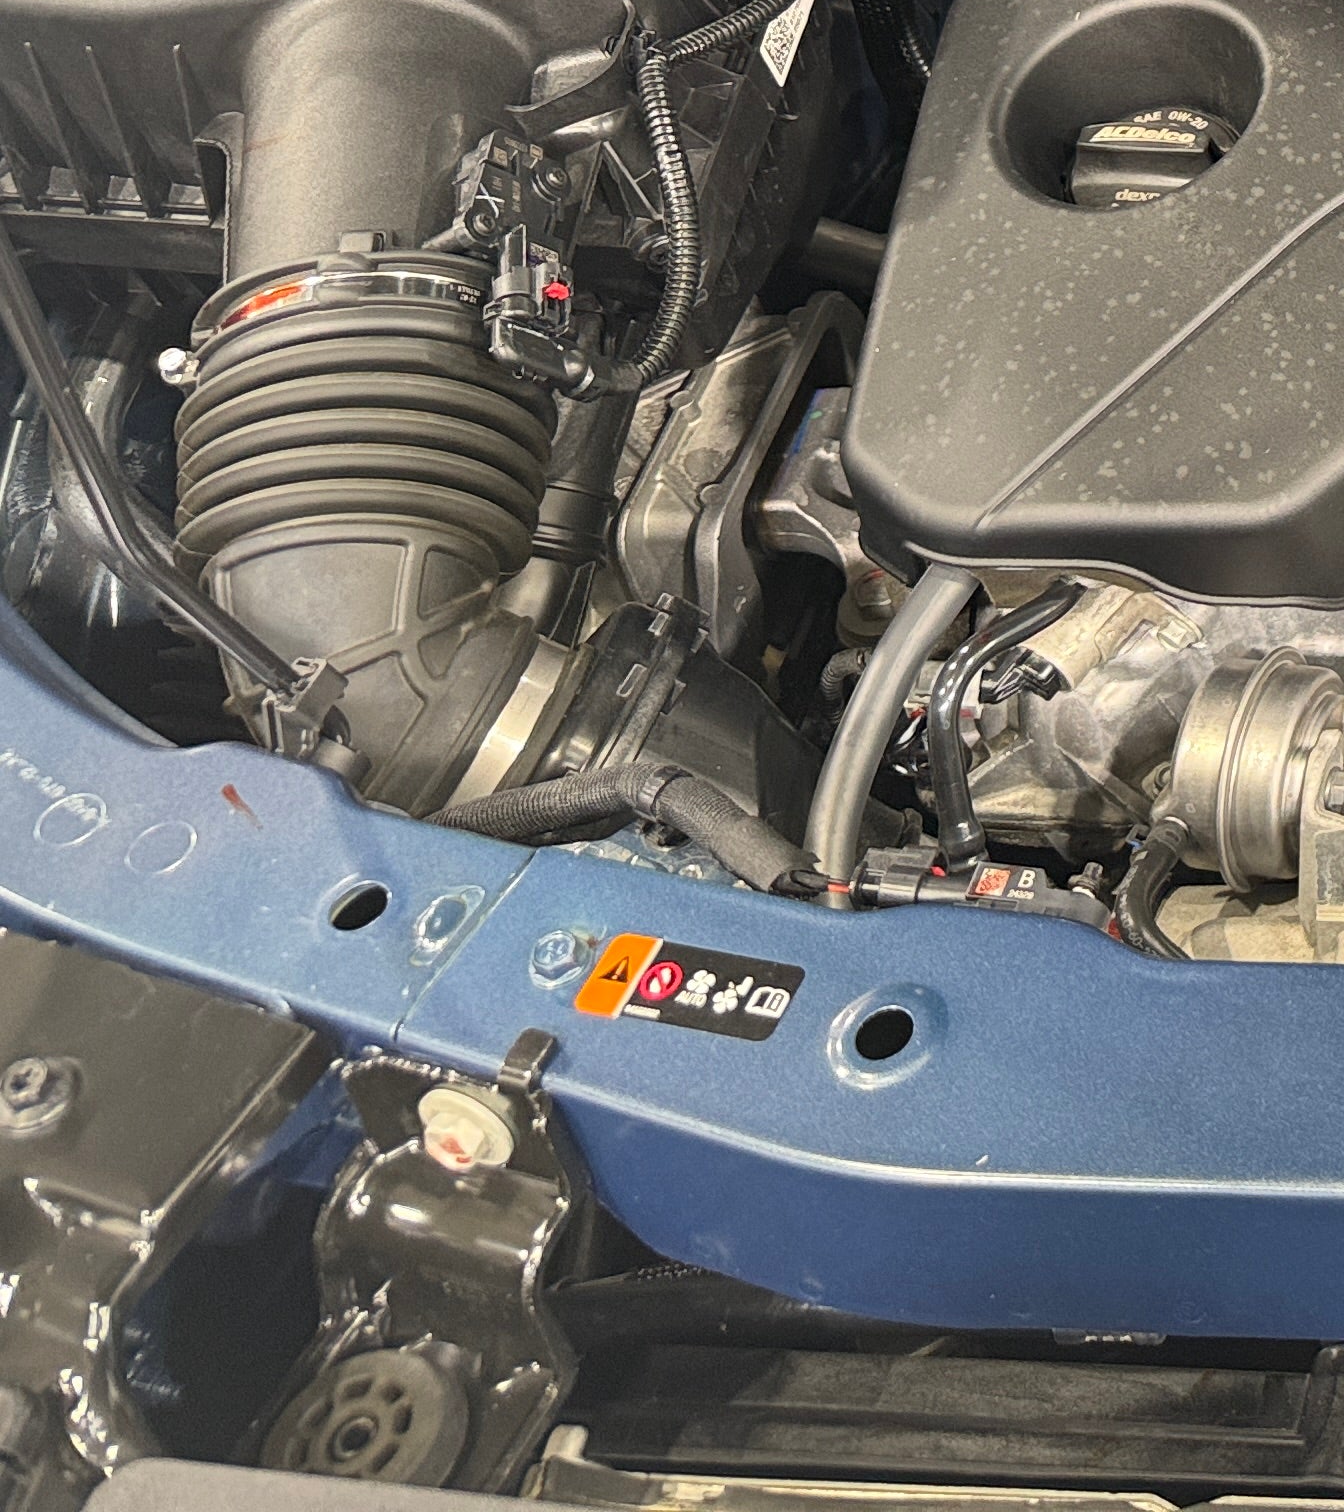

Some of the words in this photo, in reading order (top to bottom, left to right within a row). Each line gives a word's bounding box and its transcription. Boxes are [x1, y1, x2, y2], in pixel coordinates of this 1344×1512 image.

[1134, 110, 1162, 123] SAE
[1090, 126, 1196, 144] ACDelco
[1017, 869, 1036, 889] B
[674, 990, 707, 1008] AUTO
